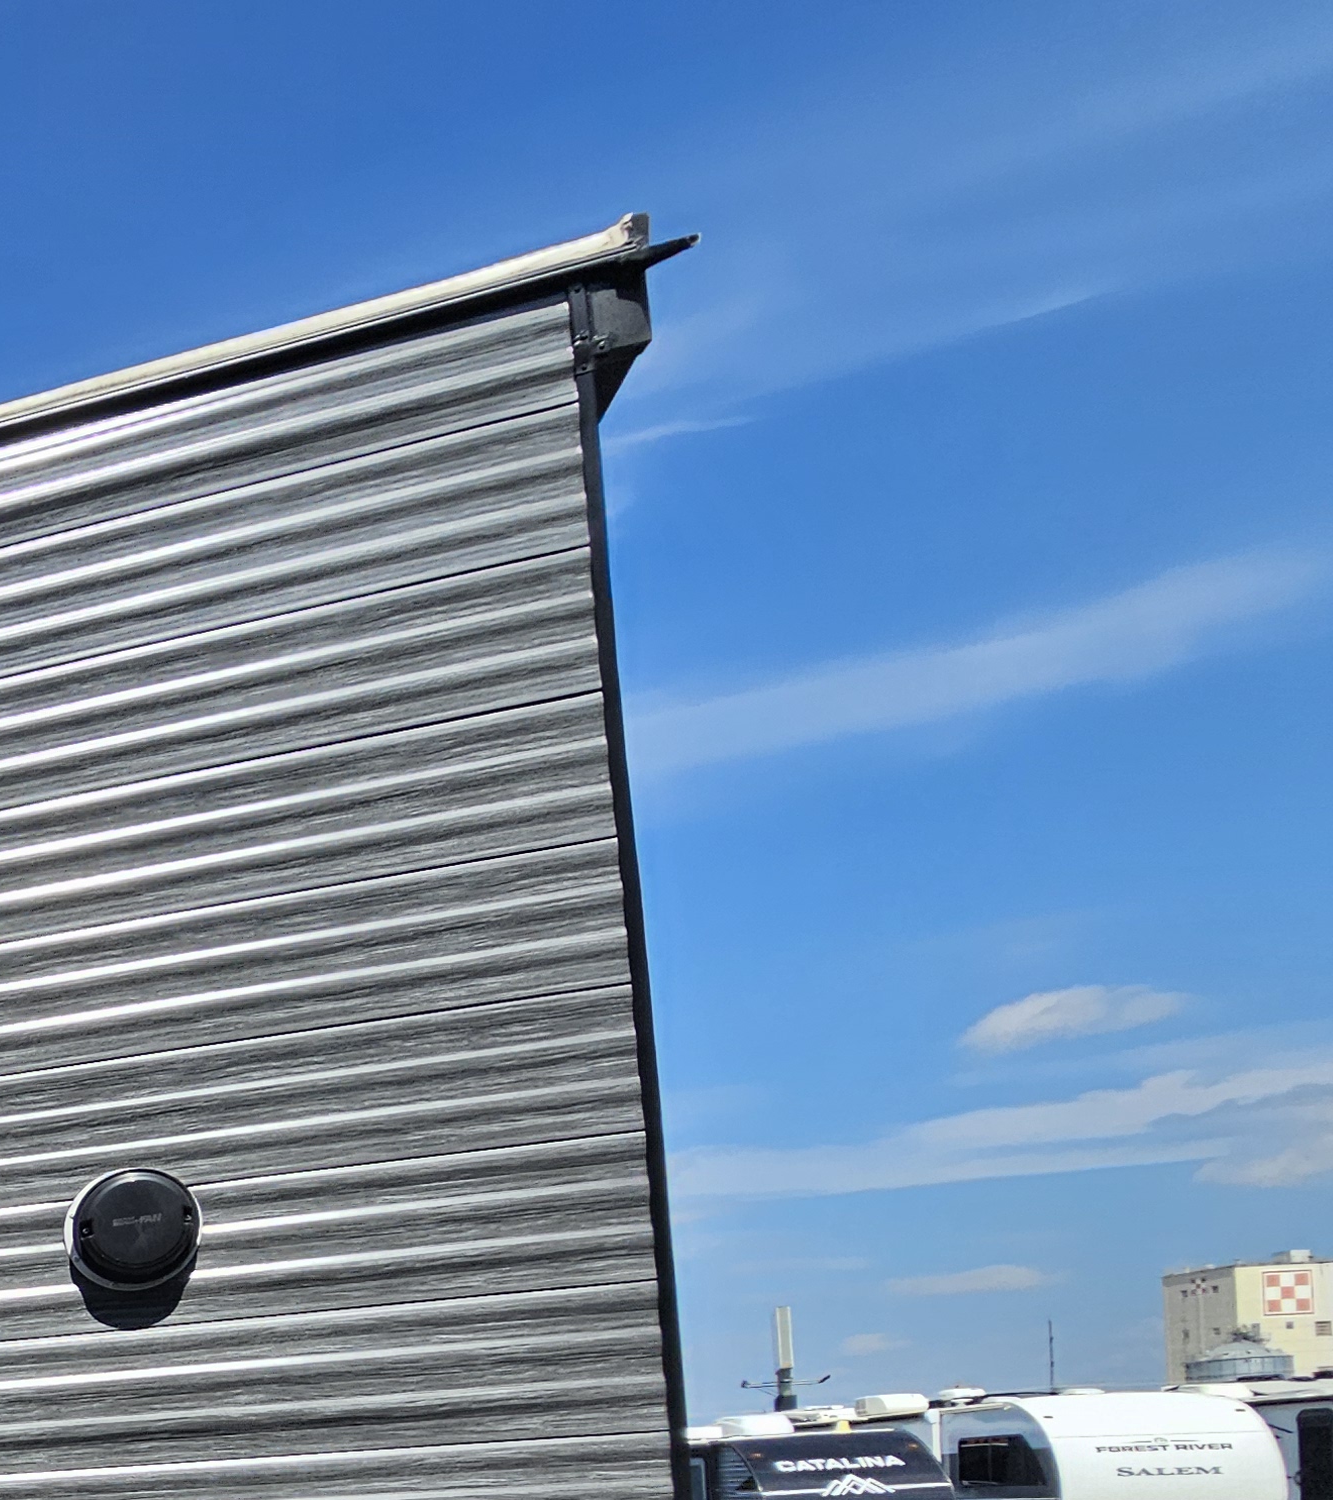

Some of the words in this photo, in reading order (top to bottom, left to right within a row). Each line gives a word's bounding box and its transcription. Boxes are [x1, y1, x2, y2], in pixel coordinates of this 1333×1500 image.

[1095, 1444, 1170, 1453] FOREST
[1173, 1442, 1233, 1451] RIVER
[774, 1455, 906, 1473] CATALINA
[1116, 1465, 1224, 1477] SALEM
